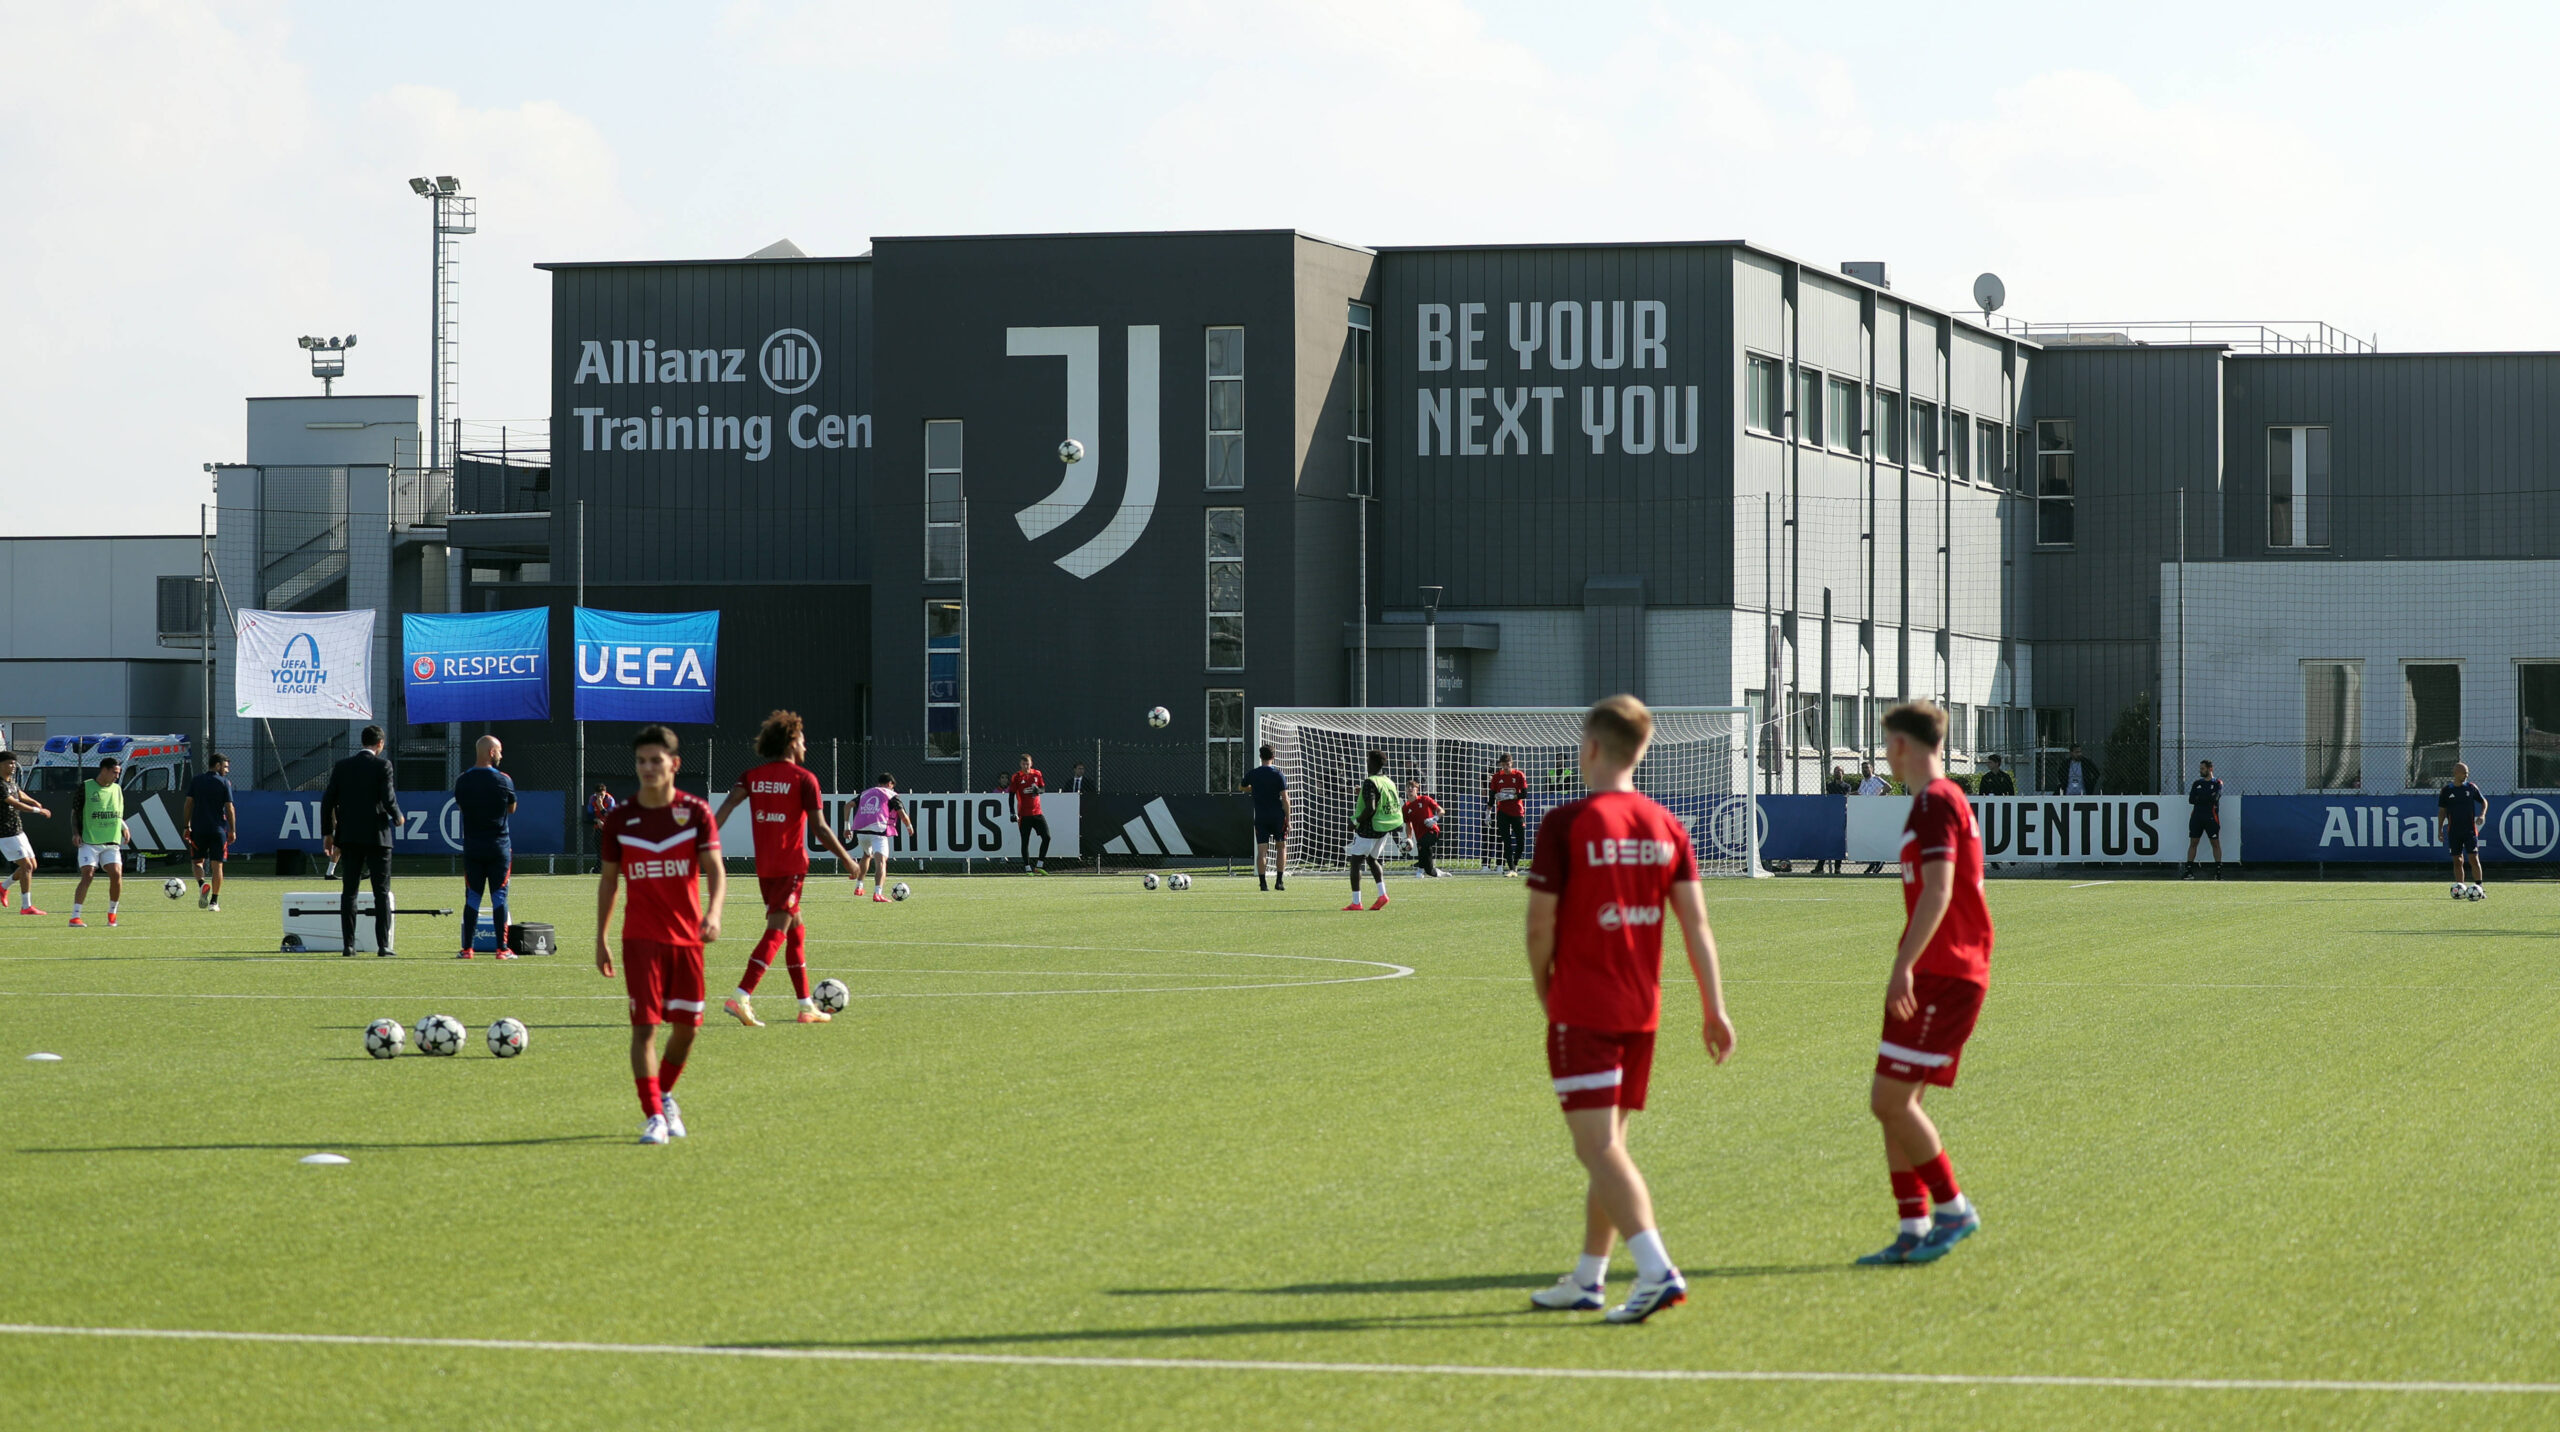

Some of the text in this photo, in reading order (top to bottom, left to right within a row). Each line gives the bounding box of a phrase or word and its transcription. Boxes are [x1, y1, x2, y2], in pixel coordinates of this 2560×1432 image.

[1418, 301, 1667, 371] BE YOUR
[574, 339, 746, 384] Allianz
[573, 404, 872, 462] Training Cen
[1418, 385, 1698, 456] NEXT YOU
[271, 669, 328, 684] YOUTH
[281, 660, 307, 669] UEFA
[443, 655, 539, 677] RESPECT
[578, 644, 708, 687] UEFA
[276, 684, 318, 694] LEAGUE
[1970, 802, 2160, 857] VENTUS
